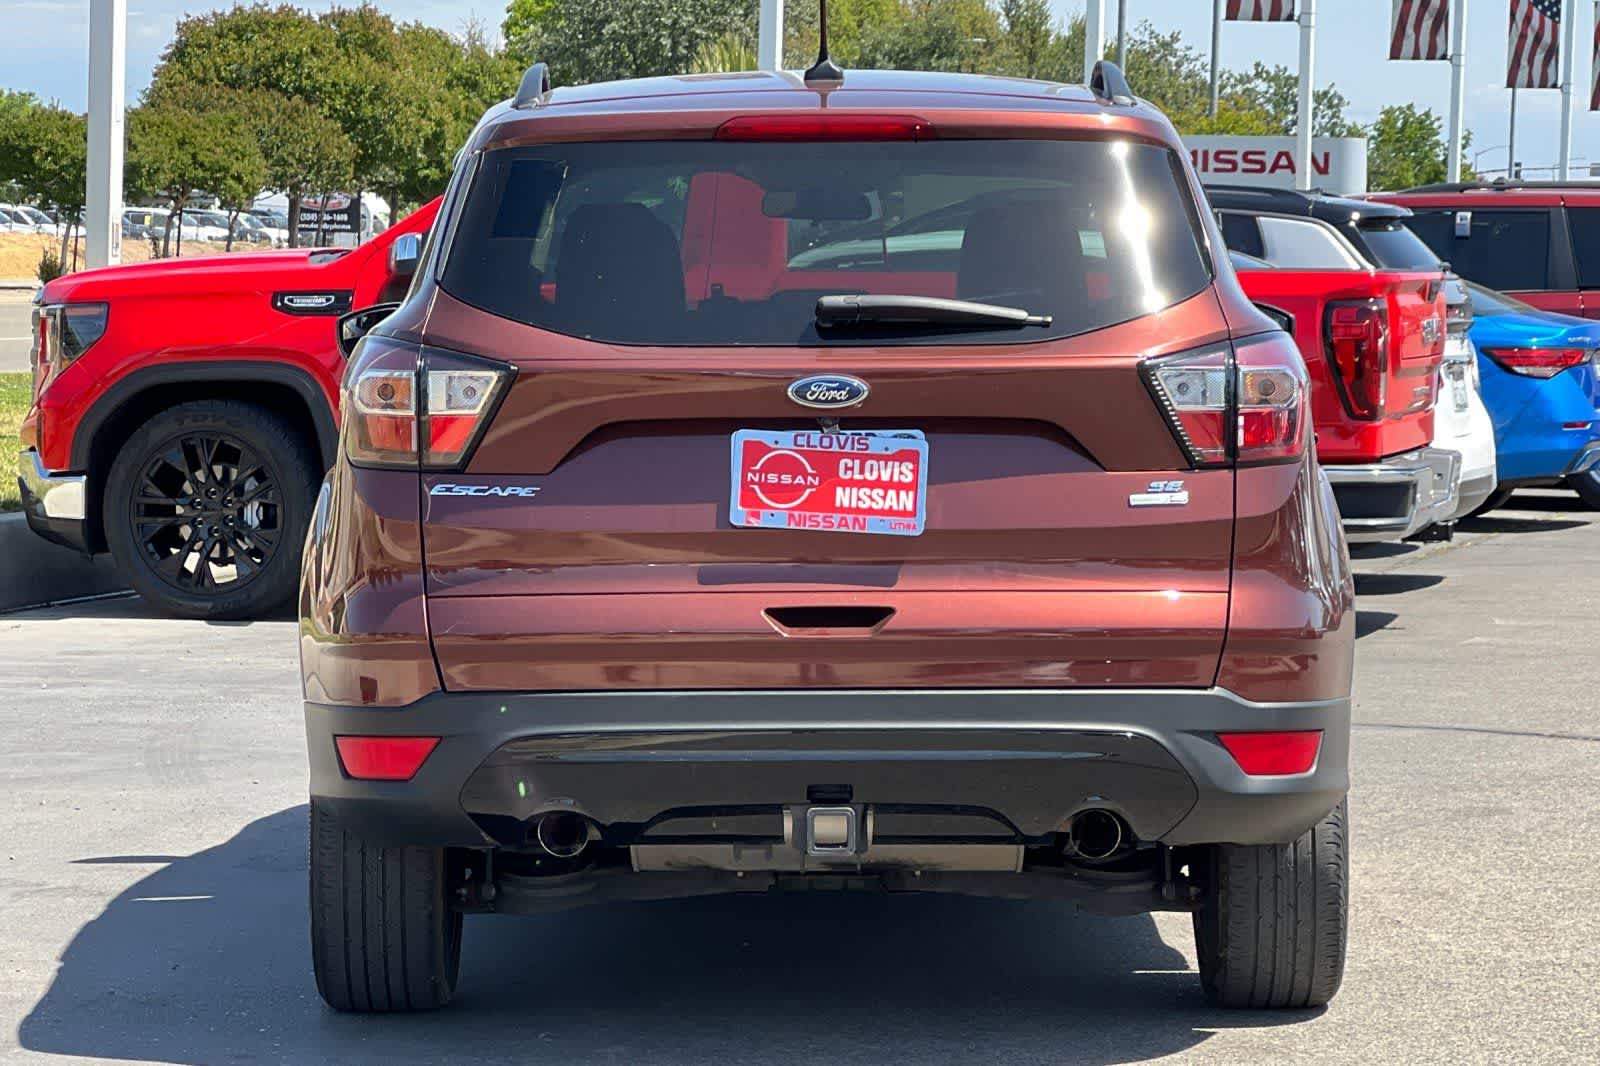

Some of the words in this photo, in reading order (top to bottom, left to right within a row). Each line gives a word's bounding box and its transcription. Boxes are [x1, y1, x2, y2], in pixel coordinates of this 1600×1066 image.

[1189, 149, 1330, 175] ISSAN
[806, 382, 850, 401] Ford
[793, 432, 870, 451] CLOVIS
[746, 472, 820, 486] NISSAN
[838, 458, 914, 483] CLOVIS
[430, 484, 541, 497] ESCAPE
[835, 487, 914, 512] NISSAN
[787, 513, 868, 531] NISSAN
